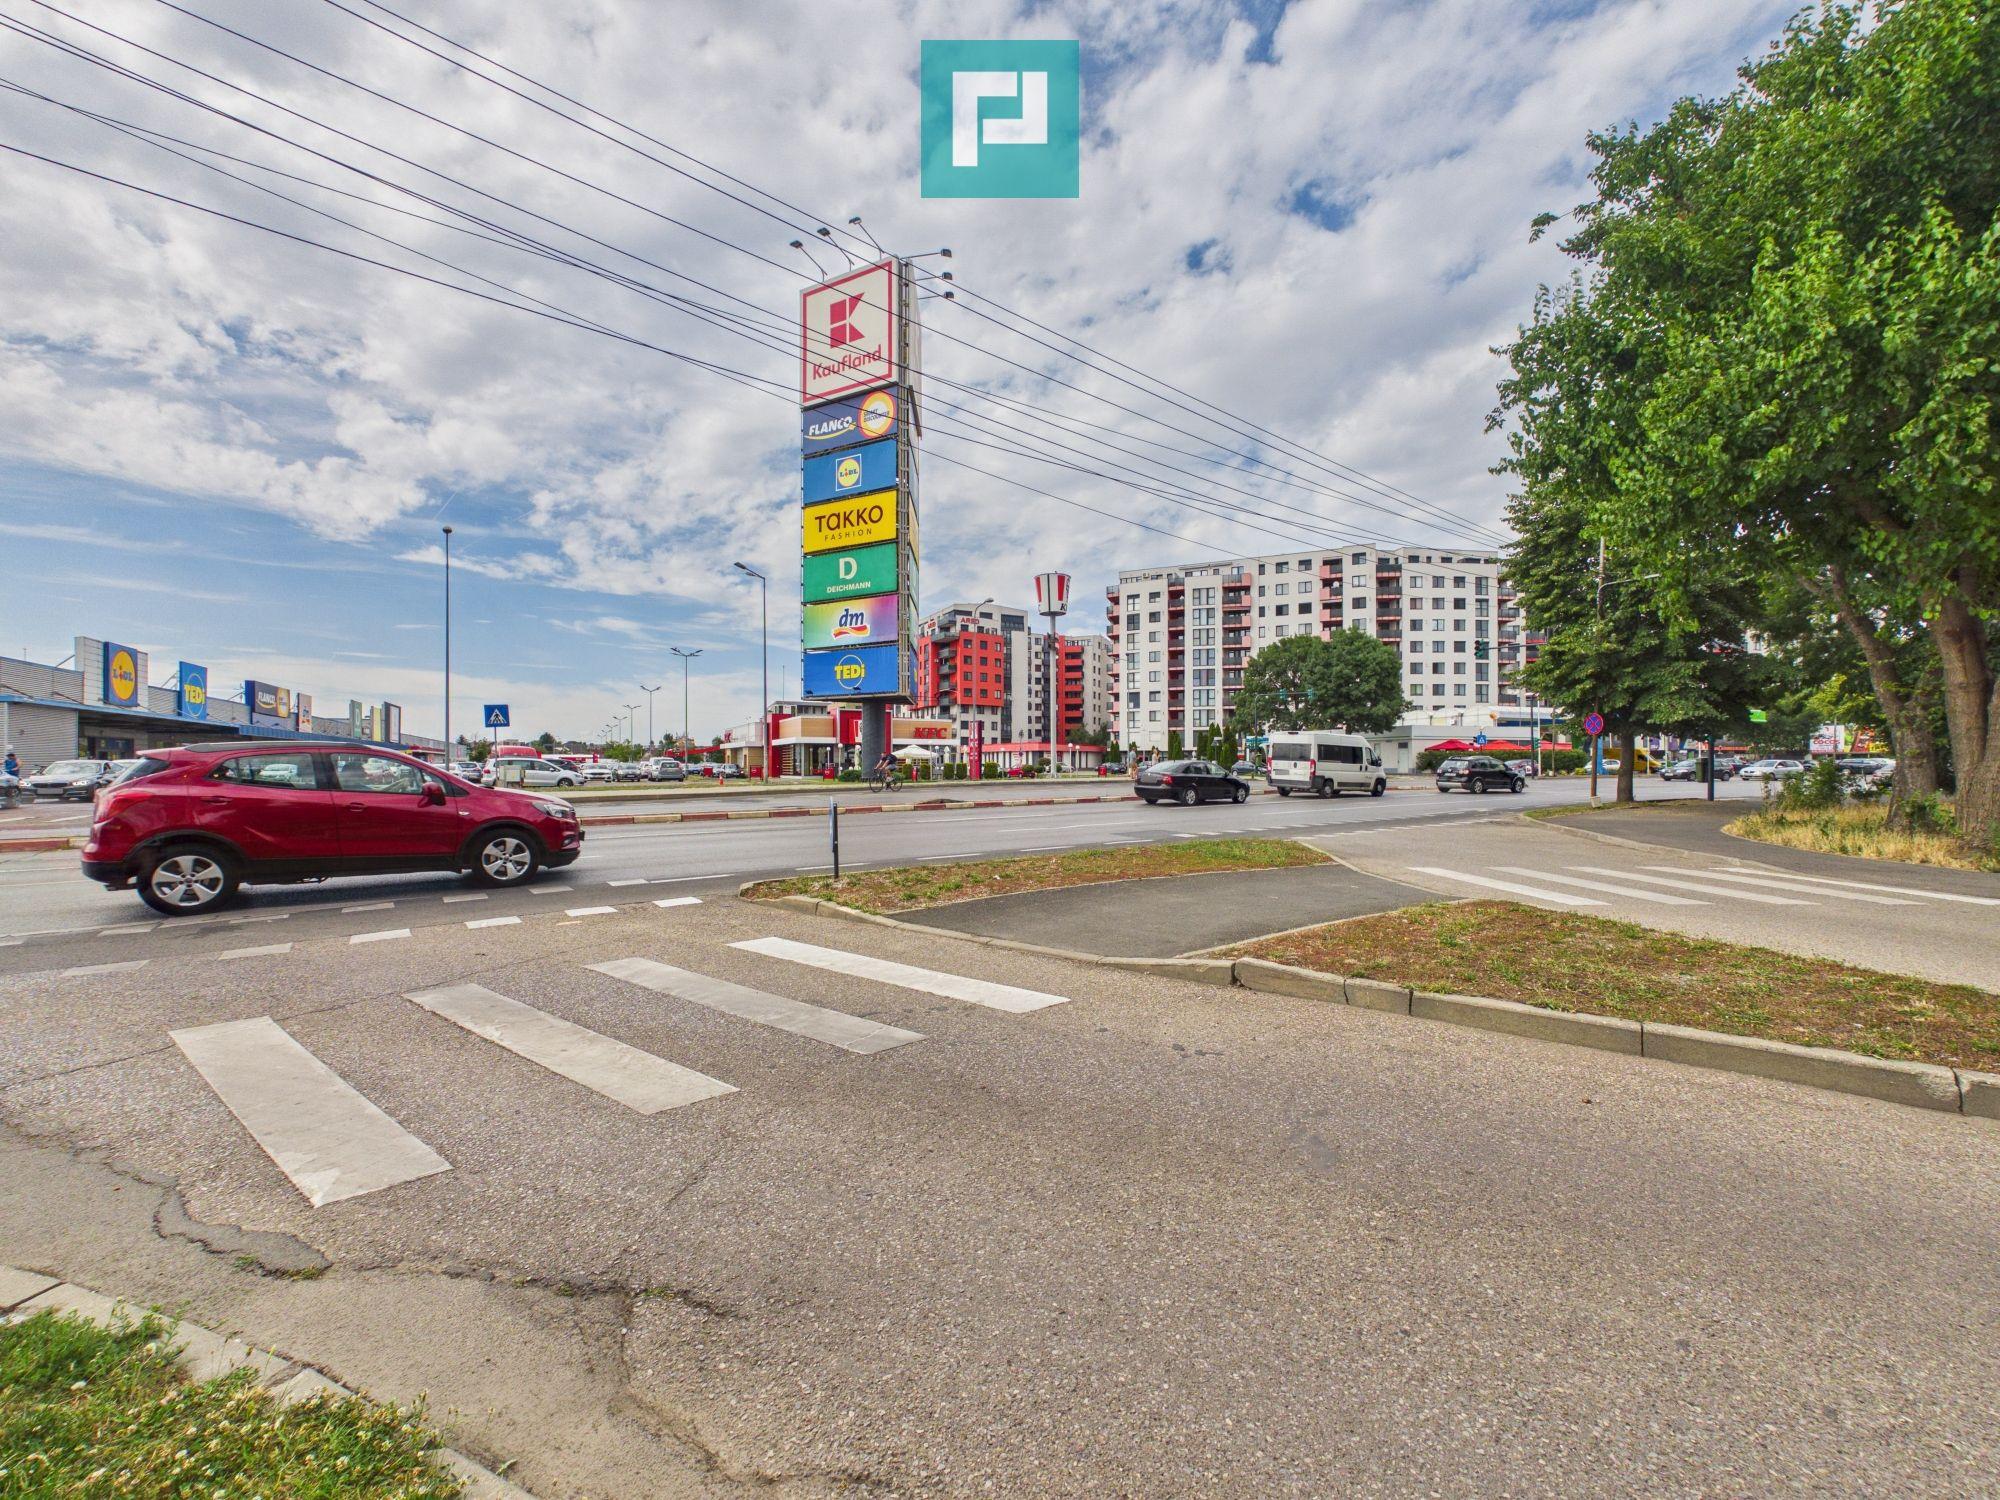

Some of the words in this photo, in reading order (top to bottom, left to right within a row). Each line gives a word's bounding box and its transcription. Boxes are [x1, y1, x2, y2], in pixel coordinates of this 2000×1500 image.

[812, 344, 882, 380] Kaufland
[808, 415, 853, 436] FLANCO
[824, 528, 873, 541] FASHION
[839, 557, 858, 580] D
[826, 581, 871, 594] DEICHMANN
[838, 608, 865, 628] dm
[834, 664, 866, 680] TEDi
[912, 727, 948, 740] KFC
